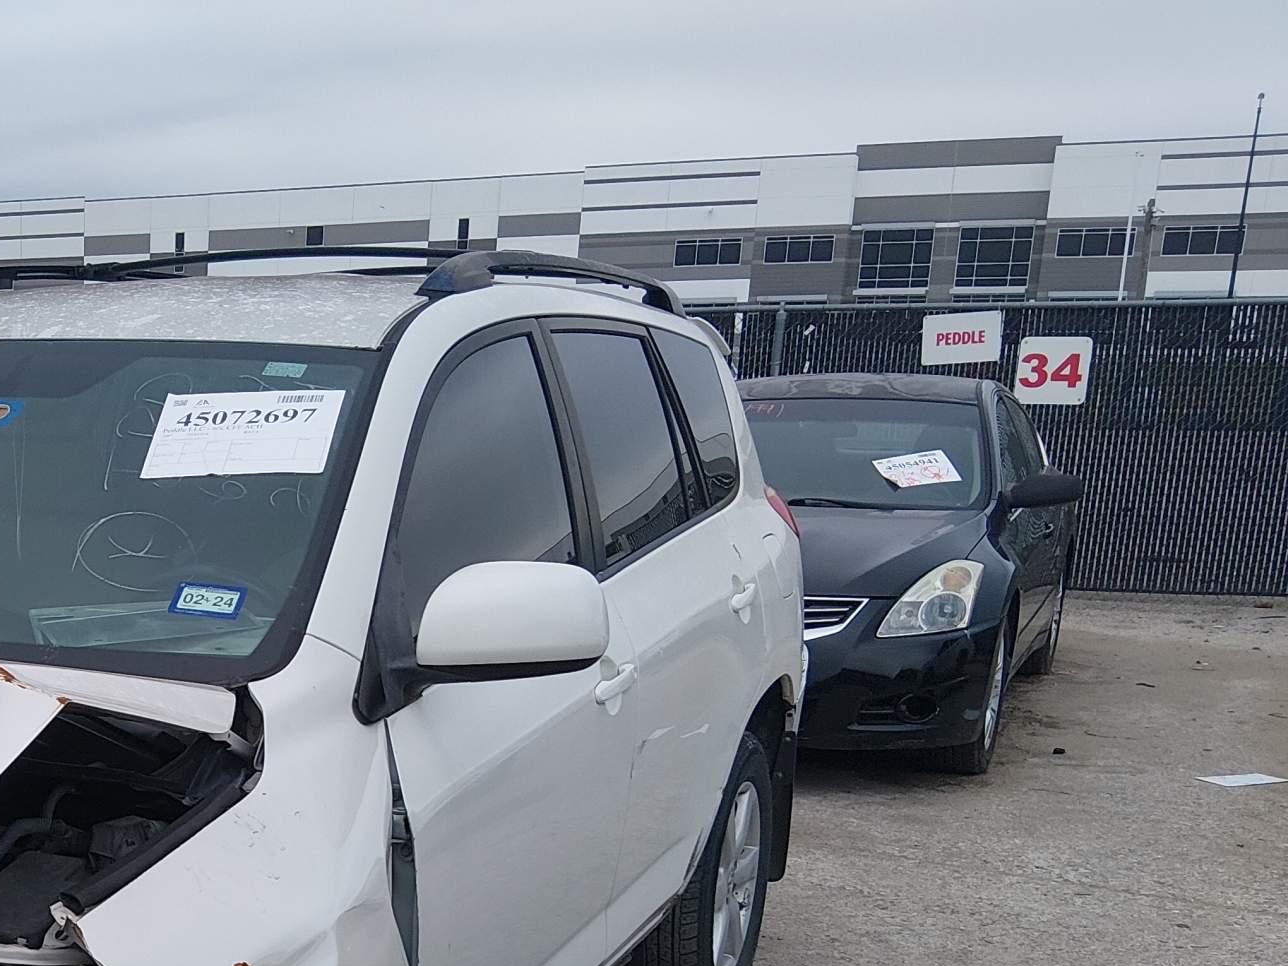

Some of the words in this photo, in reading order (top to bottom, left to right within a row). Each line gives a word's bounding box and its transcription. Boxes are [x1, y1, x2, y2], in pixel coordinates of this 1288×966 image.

[936, 330, 985, 346] PEDDLE
[1019, 353, 1082, 388] 34
[176, 407, 318, 428] 45072697
[183, 593, 204, 605] 02
[212, 596, 234, 607] 24
